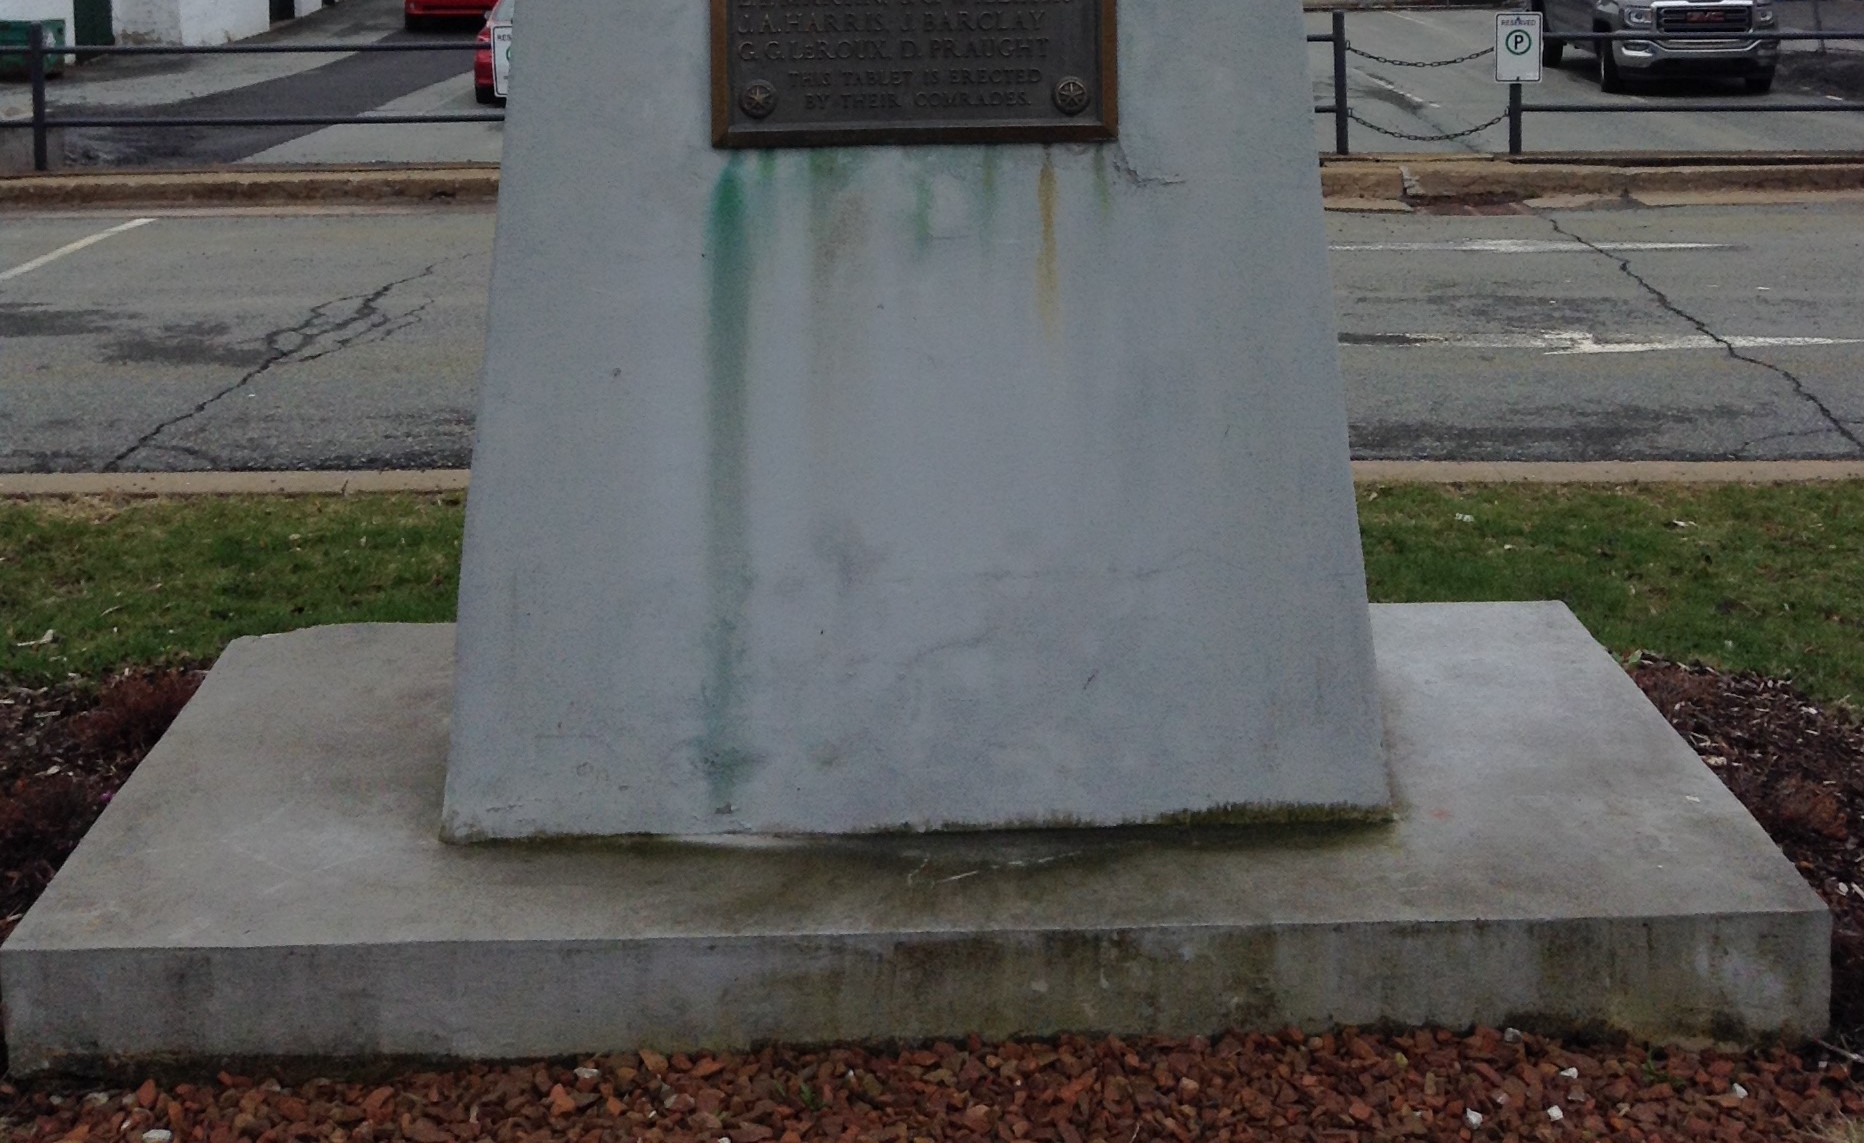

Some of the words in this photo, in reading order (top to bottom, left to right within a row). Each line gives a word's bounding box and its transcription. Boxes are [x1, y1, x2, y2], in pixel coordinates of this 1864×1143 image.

[923, 10, 1046, 31] BARCLAY
[1514, 34, 1525, 50] P
[788, 71, 833, 87] THIS
[841, 69, 913, 87] TABLET
[923, 69, 941, 85] IS
[950, 68, 1043, 84] ERECTED
[805, 93, 830, 109] BY
[839, 92, 901, 108] THEIR
